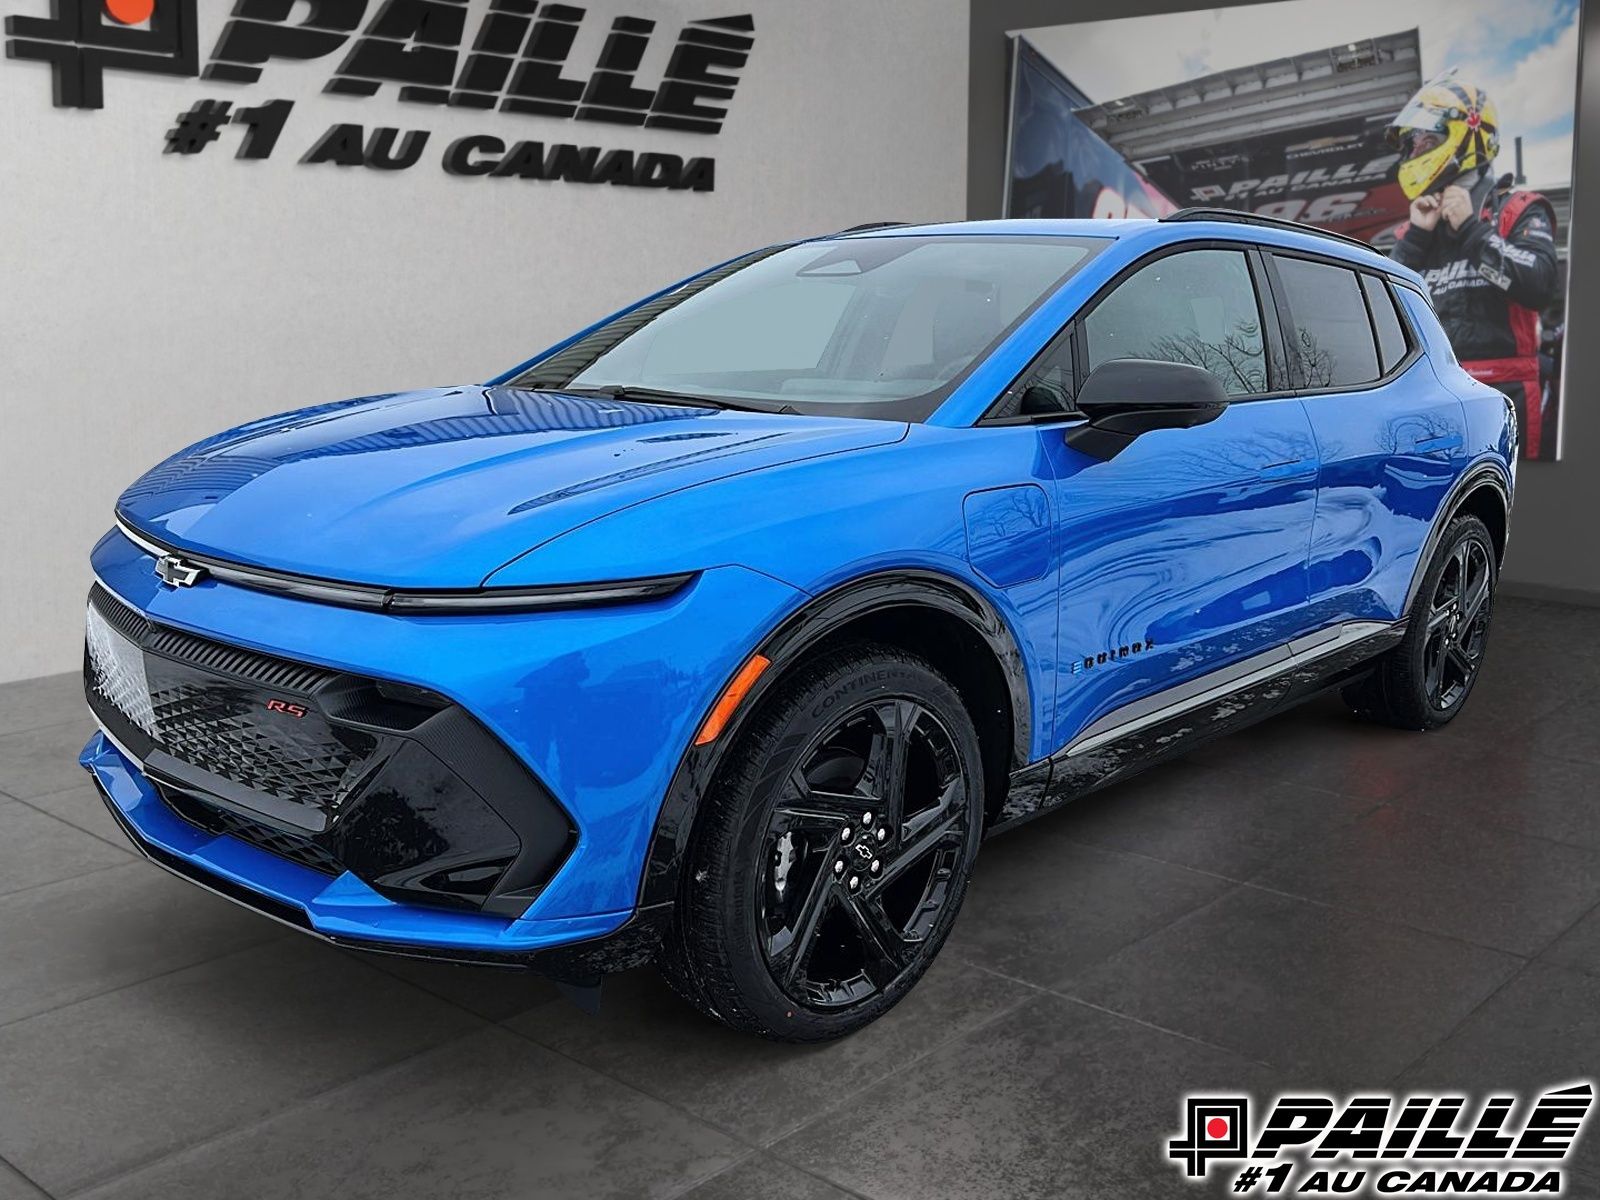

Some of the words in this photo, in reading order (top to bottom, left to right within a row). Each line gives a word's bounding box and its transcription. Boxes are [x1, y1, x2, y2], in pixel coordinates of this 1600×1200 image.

[200, 0, 755, 134] PAILLÉ
[162, 98, 295, 159] #1
[297, 123, 431, 170] AU
[442, 135, 714, 192] CANADA
[266, 699, 309, 718] RS
